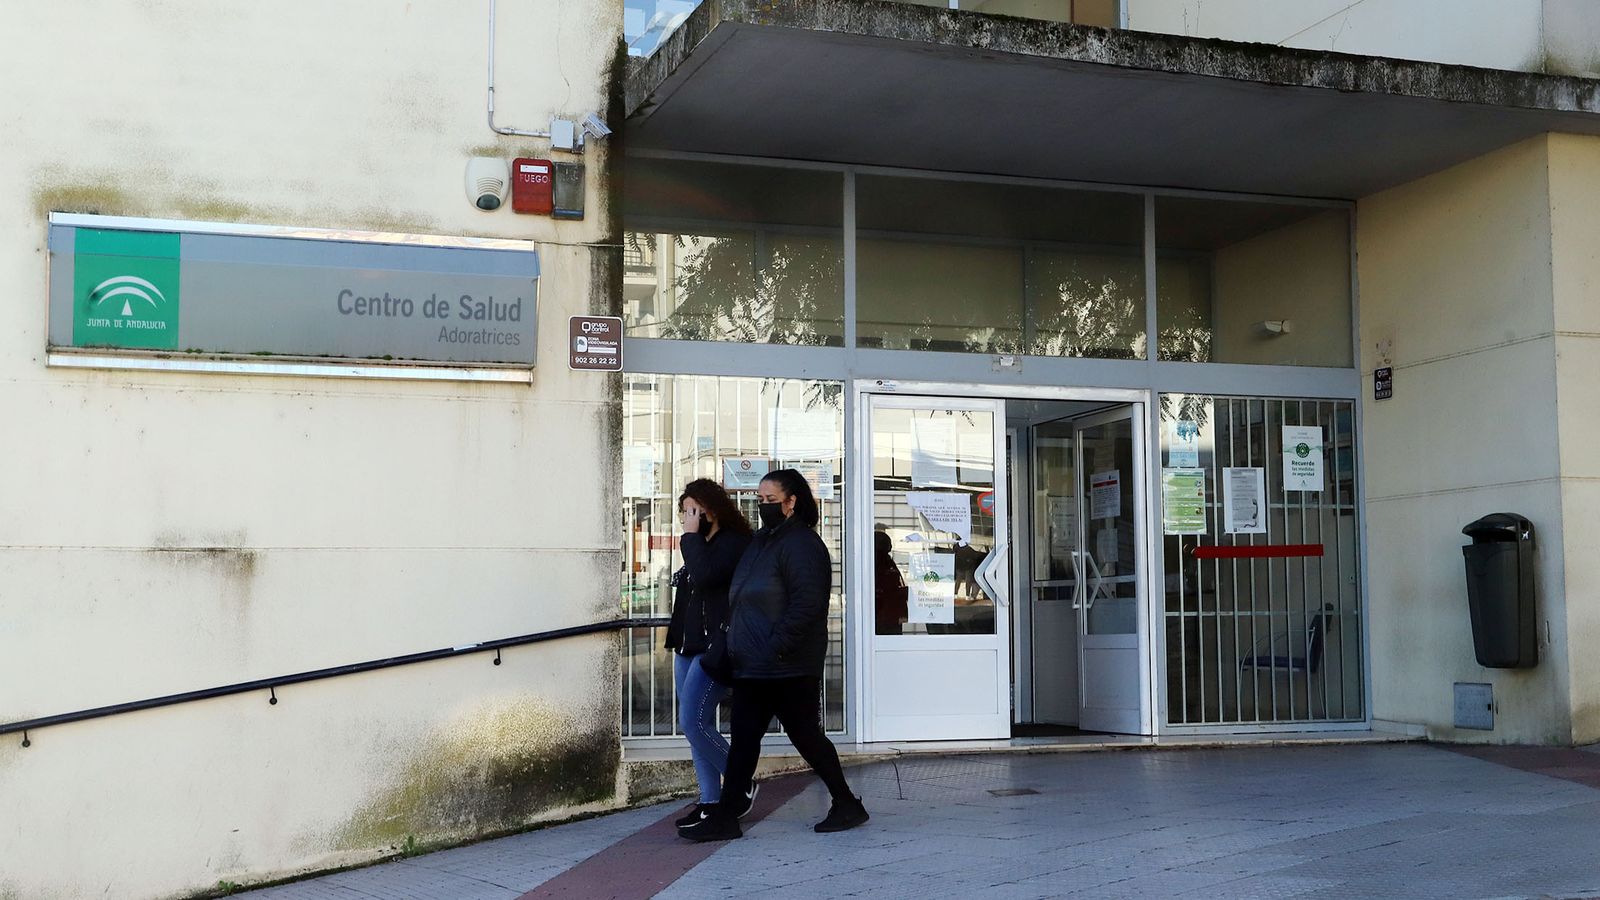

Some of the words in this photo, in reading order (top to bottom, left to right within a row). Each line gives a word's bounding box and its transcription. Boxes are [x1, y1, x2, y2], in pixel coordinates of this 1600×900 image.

[520, 174, 549, 184] FUEGO
[337, 289, 414, 318] Centro
[422, 293, 450, 319] de
[459, 294, 521, 322] Salud
[86, 318, 111, 328] JUNTA
[114, 319, 123, 328] DE
[438, 326, 520, 346] Adoratrices
[575, 356, 588, 364] 902
